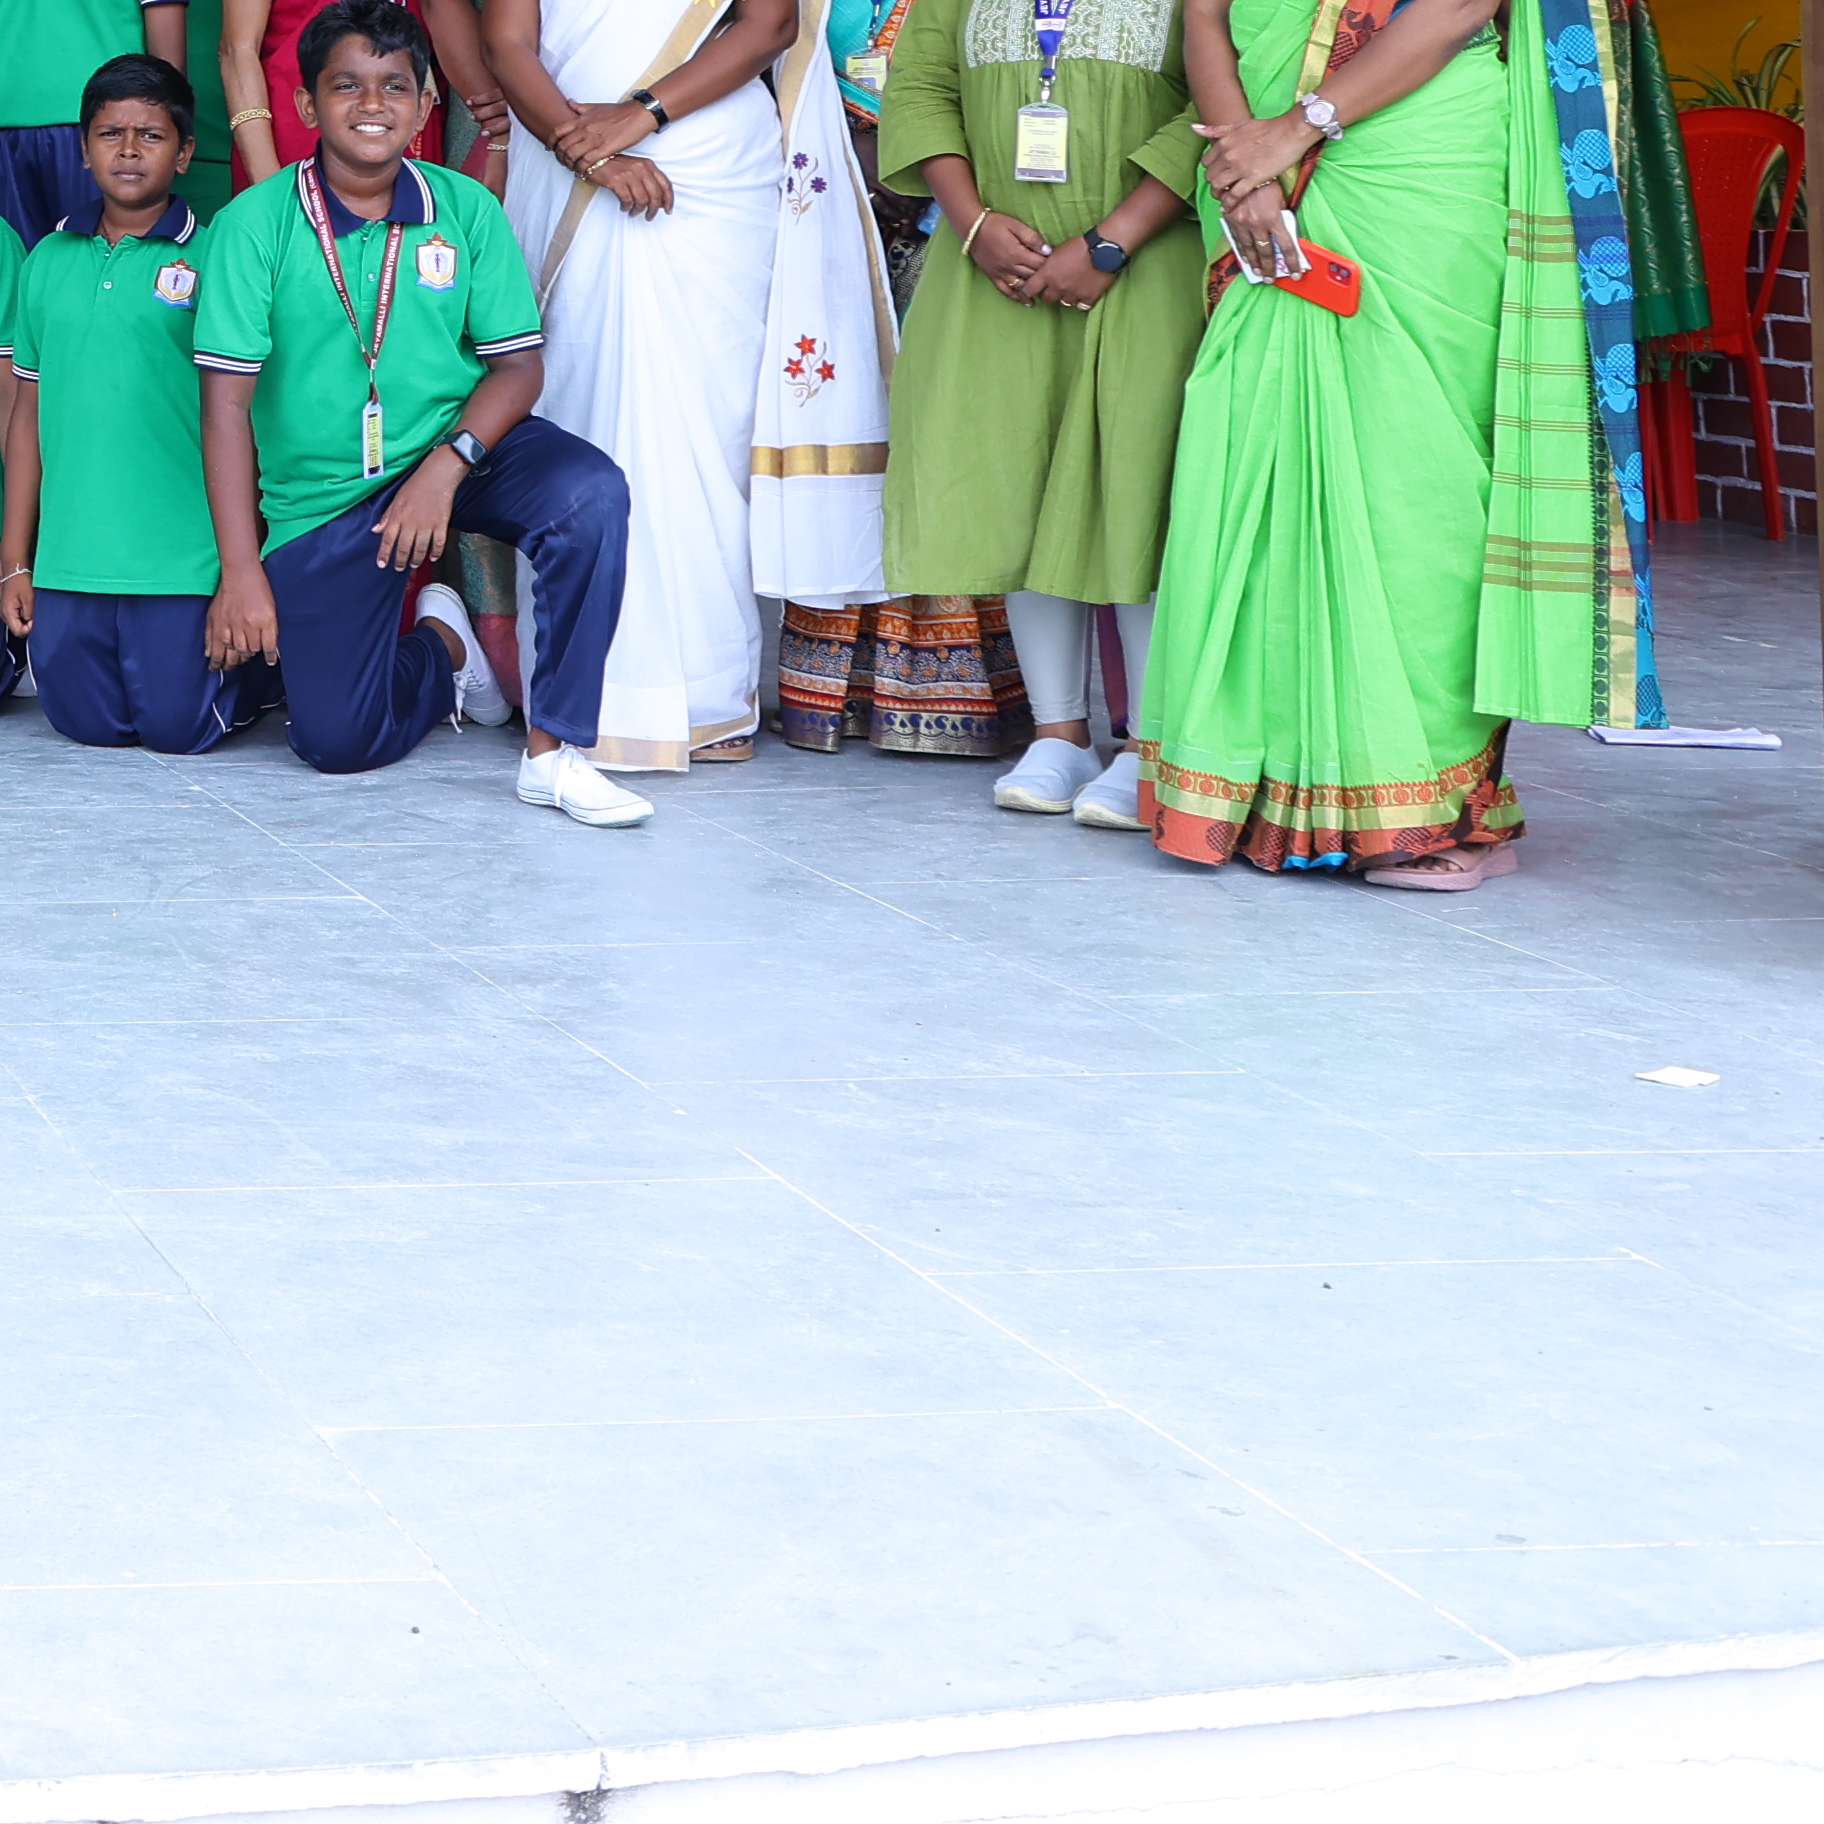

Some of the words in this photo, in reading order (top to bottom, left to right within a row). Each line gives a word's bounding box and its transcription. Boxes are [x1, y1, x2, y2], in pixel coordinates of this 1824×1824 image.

[309, 189, 324, 222] SCHOOL
[319, 223, 342, 291] INTERNATIONAL
[381, 235, 398, 303] INTERNATIONAL
